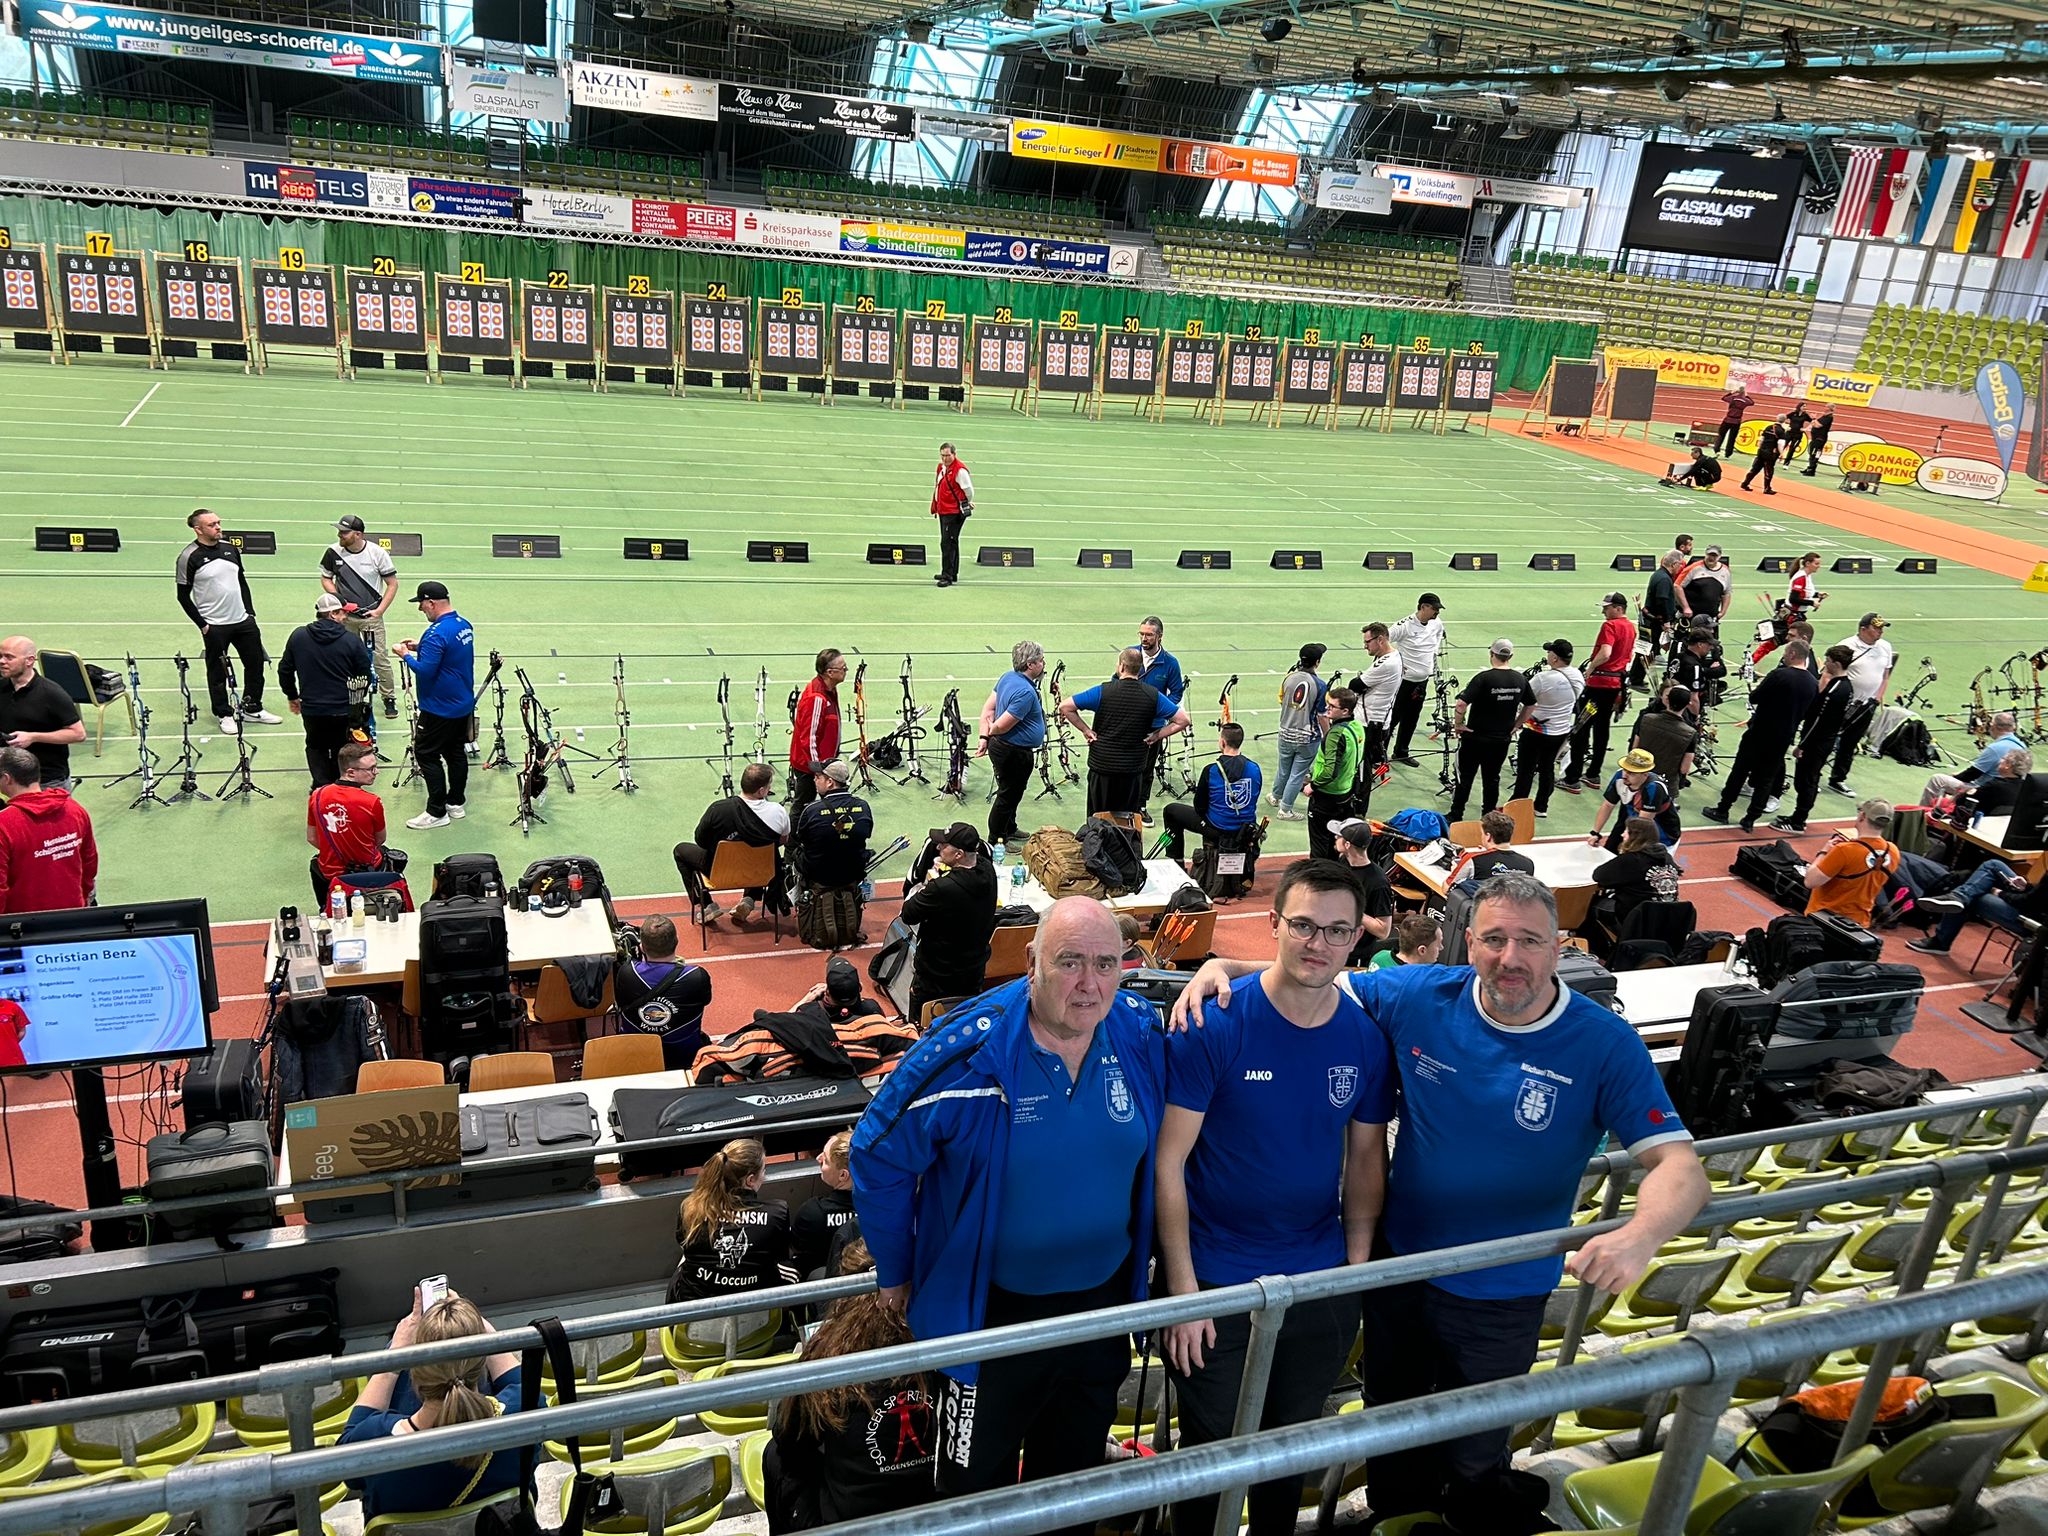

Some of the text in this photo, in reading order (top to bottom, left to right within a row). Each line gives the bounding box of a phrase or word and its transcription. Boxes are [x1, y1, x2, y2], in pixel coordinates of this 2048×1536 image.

[30, 28, 71, 38] JUNGEILGES
[79, 33, 112, 42] SCHÖFFEL
[105, 15, 364, 55] www.jungeilges-schoeffel.de
[360, 65, 396, 74] JUNGEILGES
[404, 70, 433, 79] SCHÖFFEL
[578, 70, 649, 90] AKZENT
[586, 86, 641, 100] HOTEL
[735, 88, 762, 106] Klauss
[776, 93, 802, 112] Klauss
[474, 94, 540, 110] GLASPALAST
[584, 94, 642, 108] Torgauer Hof
[474, 104, 519, 115] SINDELFINGEN
[720, 104, 786, 119] Festwirte auf dem Wasen
[833, 100, 898, 123] Klauss Klauss
[748, 116, 790, 128] Getränkehandel
[790, 120, 801, 128] und
[819, 117, 842, 126] Festwirte
[1022, 141, 1102, 158] Energie für Sieger
[1125, 145, 1158, 155] Stadtwerke
[1252, 159, 1290, 170] Gut. Besser.
[370, 180, 406, 189] AUTOHOF
[413, 181, 488, 195] Fahrschule Rolf
[1417, 176, 1456, 190] Volksbank
[281, 184, 314, 197] ABCD
[1414, 188, 1462, 202] Sindelfingen
[1711, 187, 1778, 201] Arena des Erfolges
[446, 195, 463, 203] etwas
[465, 197, 484, 205] andere
[486, 199, 513, 207] Fahrschu
[542, 194, 614, 214] HotelBerlin
[1330, 193, 1374, 205] GLASPALAST
[1661, 198, 1756, 219] GLASPALAST
[687, 209, 732, 227] PETERS
[1659, 212, 1724, 226] SINDELFINGEN
[641, 222, 679, 230] CONTAINER-
[762, 223, 833, 237] Kreissparkasse
[762, 235, 810, 248] Böblingen
[877, 226, 962, 245] Badezentrum
[88, 236, 110, 253] 17
[186, 243, 208, 260] 18
[877, 238, 958, 256] Sindelfingen
[282, 250, 303, 267] 19
[374, 258, 394, 275] 20
[464, 266, 483, 282] 21
[549, 272, 568, 288] 22
[630, 278, 648, 294] 23
[708, 284, 726, 300] 24
[784, 291, 801, 307] 25
[857, 297, 874, 312] 26
[928, 303, 944, 317] 27
[995, 308, 1011, 323] 28
[1062, 313, 1077, 327] 29
[1124, 319, 1139, 332] 30
[1187, 323, 1202, 336] 31
[1246, 327, 1260, 340] 32
[1305, 331, 1319, 344] 33
[1361, 336, 1375, 348] 34
[1415, 339, 1428, 351] 35
[1469, 343, 1483, 355] 36
[1678, 361, 1720, 374] LOTTO
[1813, 373, 1874, 393] Beiter
[1868, 454, 1919, 468] DANAGE
[1866, 465, 1918, 479] DOMINO
[1947, 470, 1997, 485] DOMINO
[71, 535, 81, 543] 18
[231, 538, 242, 546] 19
[380, 540, 390, 548] 20
[522, 543, 531, 551] 21
[35, 949, 137, 965] Christian Benz
[1102, 1056, 1109, 1065] H.
[1244, 1070, 1273, 1081] JAKO
[1520, 1063, 1573, 1085] Michael Thomas
[310, 1144, 338, 1180] feey
[696, 1267, 758, 1286] SV Loccum
[40, 1332, 114, 1347] LEGEND
[956, 1384, 977, 1468] TERSPORT
[865, 1408, 887, 1466] SOLINGER
[880, 1455, 934, 1473] BOGENSCHÜTZ
